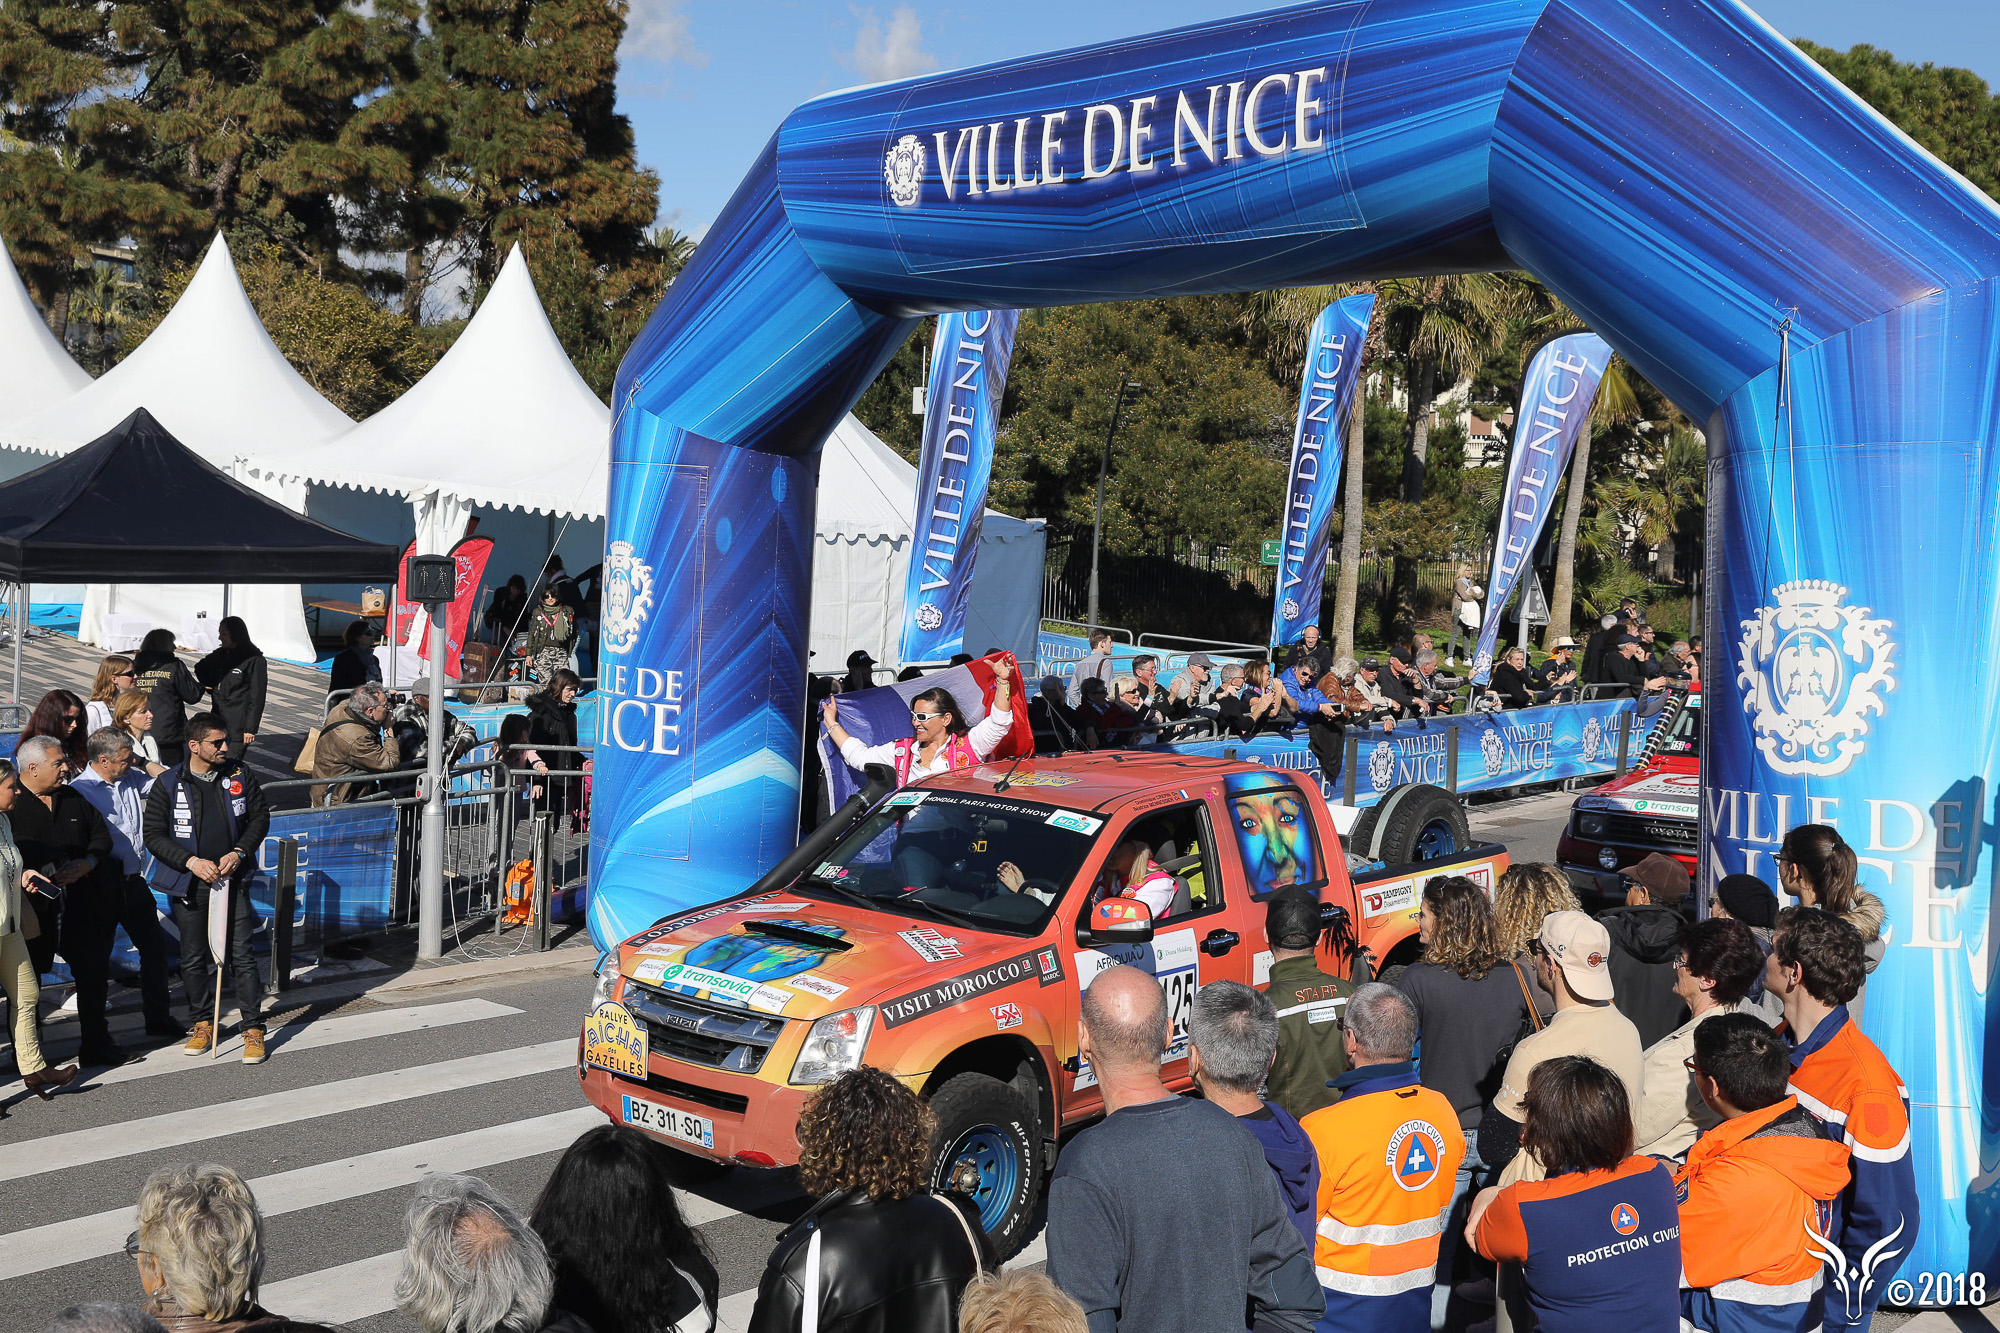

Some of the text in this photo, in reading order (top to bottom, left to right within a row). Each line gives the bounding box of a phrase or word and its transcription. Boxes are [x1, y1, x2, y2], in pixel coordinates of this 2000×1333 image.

[932, 65, 1326, 200] VILLE DE NICE
[1530, 348, 1588, 460] NICE
[919, 310, 991, 595] VILLE DE NIC
[1283, 332, 1346, 590] VILLE DE NICE
[1514, 467, 1548, 525] DE
[1040, 641, 1088, 659] VILLE DE
[1039, 657, 1077, 679] NIC
[599, 661, 683, 701] LLE DE
[1502, 721, 1552, 743] VILLE DE
[1631, 713, 1645, 728] DE
[1397, 733, 1446, 756] VILLE DE
[1508, 740, 1552, 773] NICE
[1272, 750, 1312, 770] VILLE
[1398, 752, 1446, 785] NICE
[924, 796, 1050, 818] MONDIAL PARIS MOTOR SHOW
[1651, 802, 1699, 814] transav
[1644, 826, 1689, 839] TOYOTA
[1864, 799, 1963, 853] DE
[647, 906, 734, 939] MOROCCO
[1097, 951, 1137, 971] AFRIQUIA
[682, 968, 753, 995] transavia
[1042, 970, 1061, 982] MAROC
[882, 962, 1020, 1023] VISIT MOROCCO
[1295, 984, 1338, 1002] STAFF
[599, 1008, 628, 1024] RALLYE
[667, 1014, 697, 1028] ISUZU
[586, 1049, 643, 1076] GAZELLES
[608, 1046, 617, 1054] des
[1387, 1121, 1445, 1163] PROTECTION CIVILE
[1567, 1224, 1680, 1268] PROTECTION CIVILE
